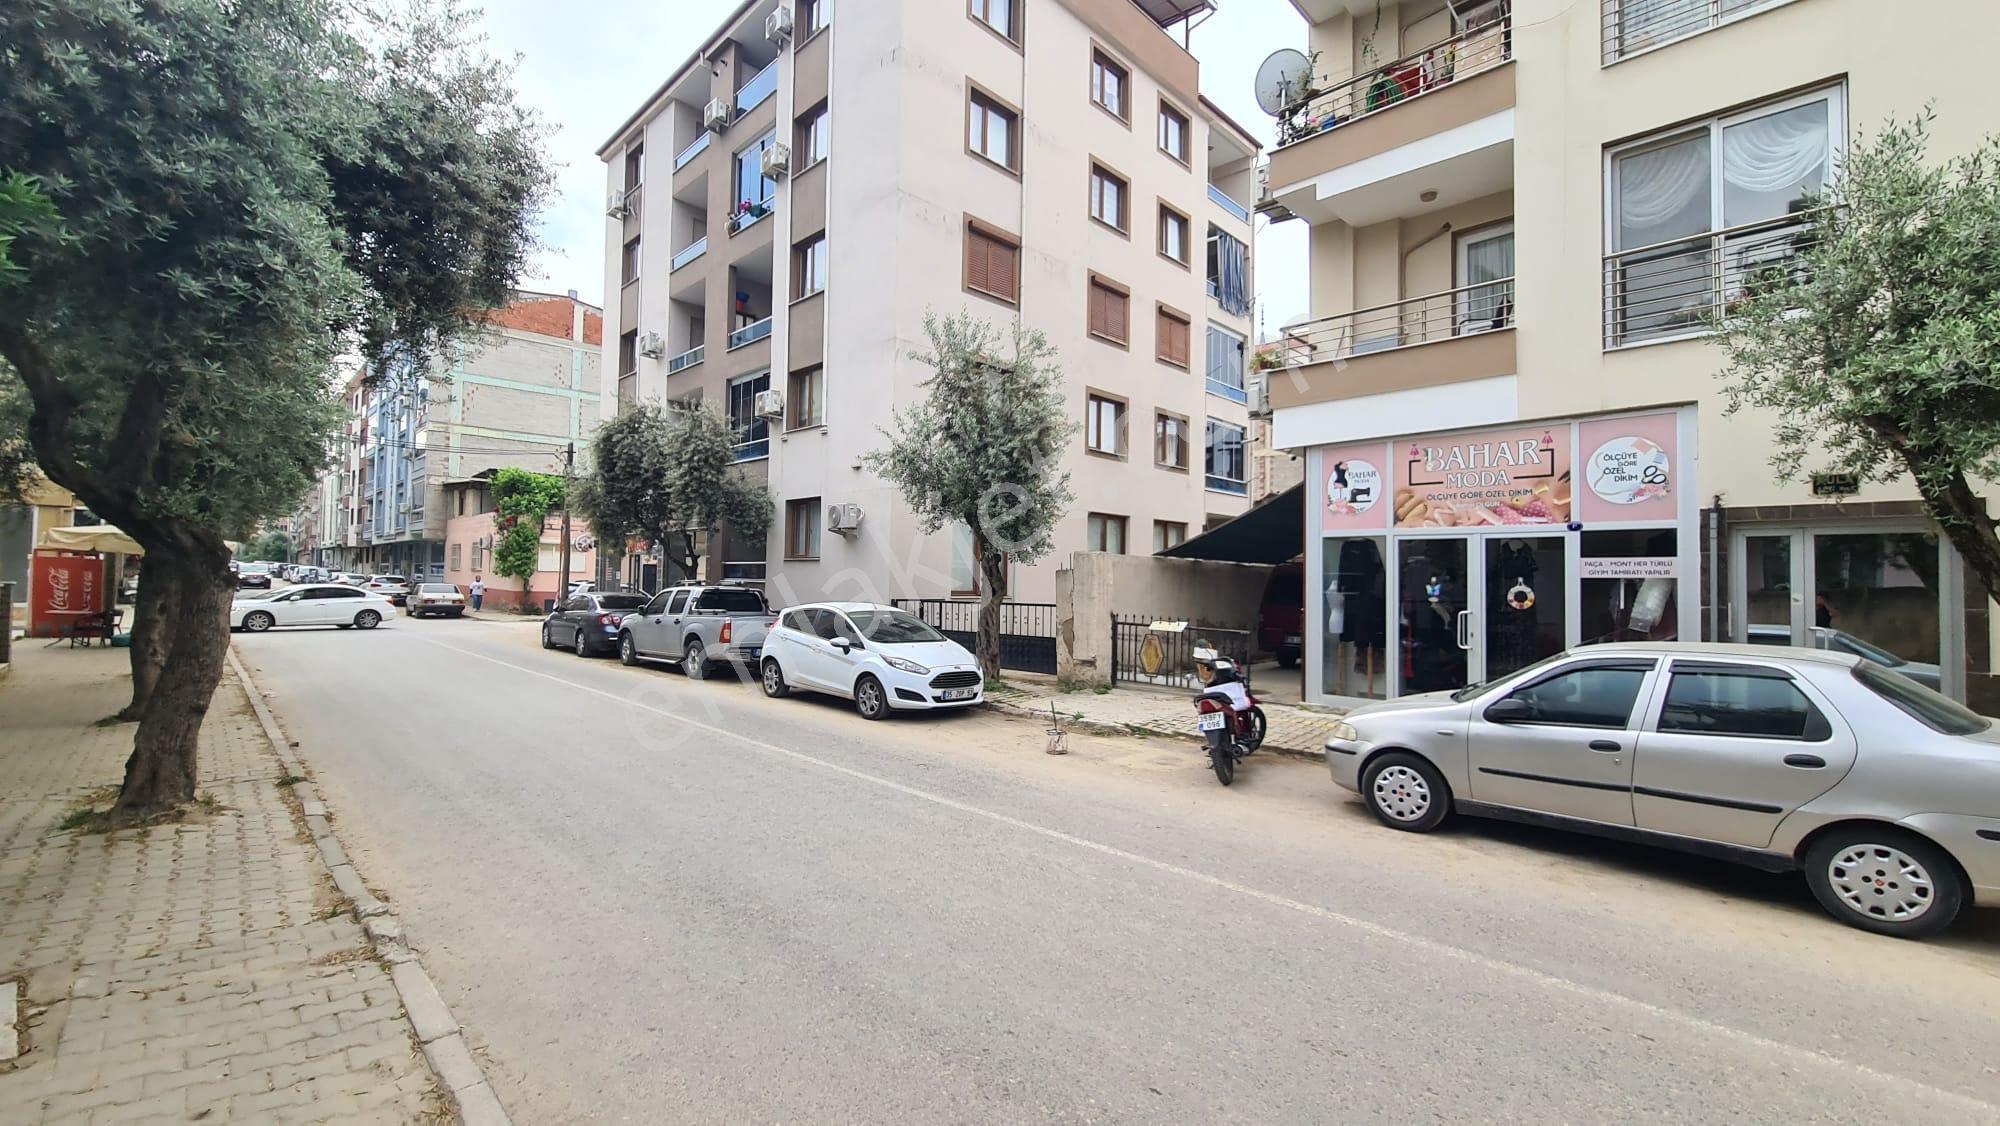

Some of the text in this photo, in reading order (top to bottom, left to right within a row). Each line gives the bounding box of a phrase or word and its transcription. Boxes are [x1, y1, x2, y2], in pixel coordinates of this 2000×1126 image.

[1424, 439, 1541, 472] BAHAR
[1603, 452, 1638, 461] ÖLÇÜYE
[1348, 471, 1377, 479] BAHAR
[1603, 467, 1626, 475] ÖZEL
[1446, 470, 1510, 489] MODA
[1614, 474, 1638, 482] DİKİM
